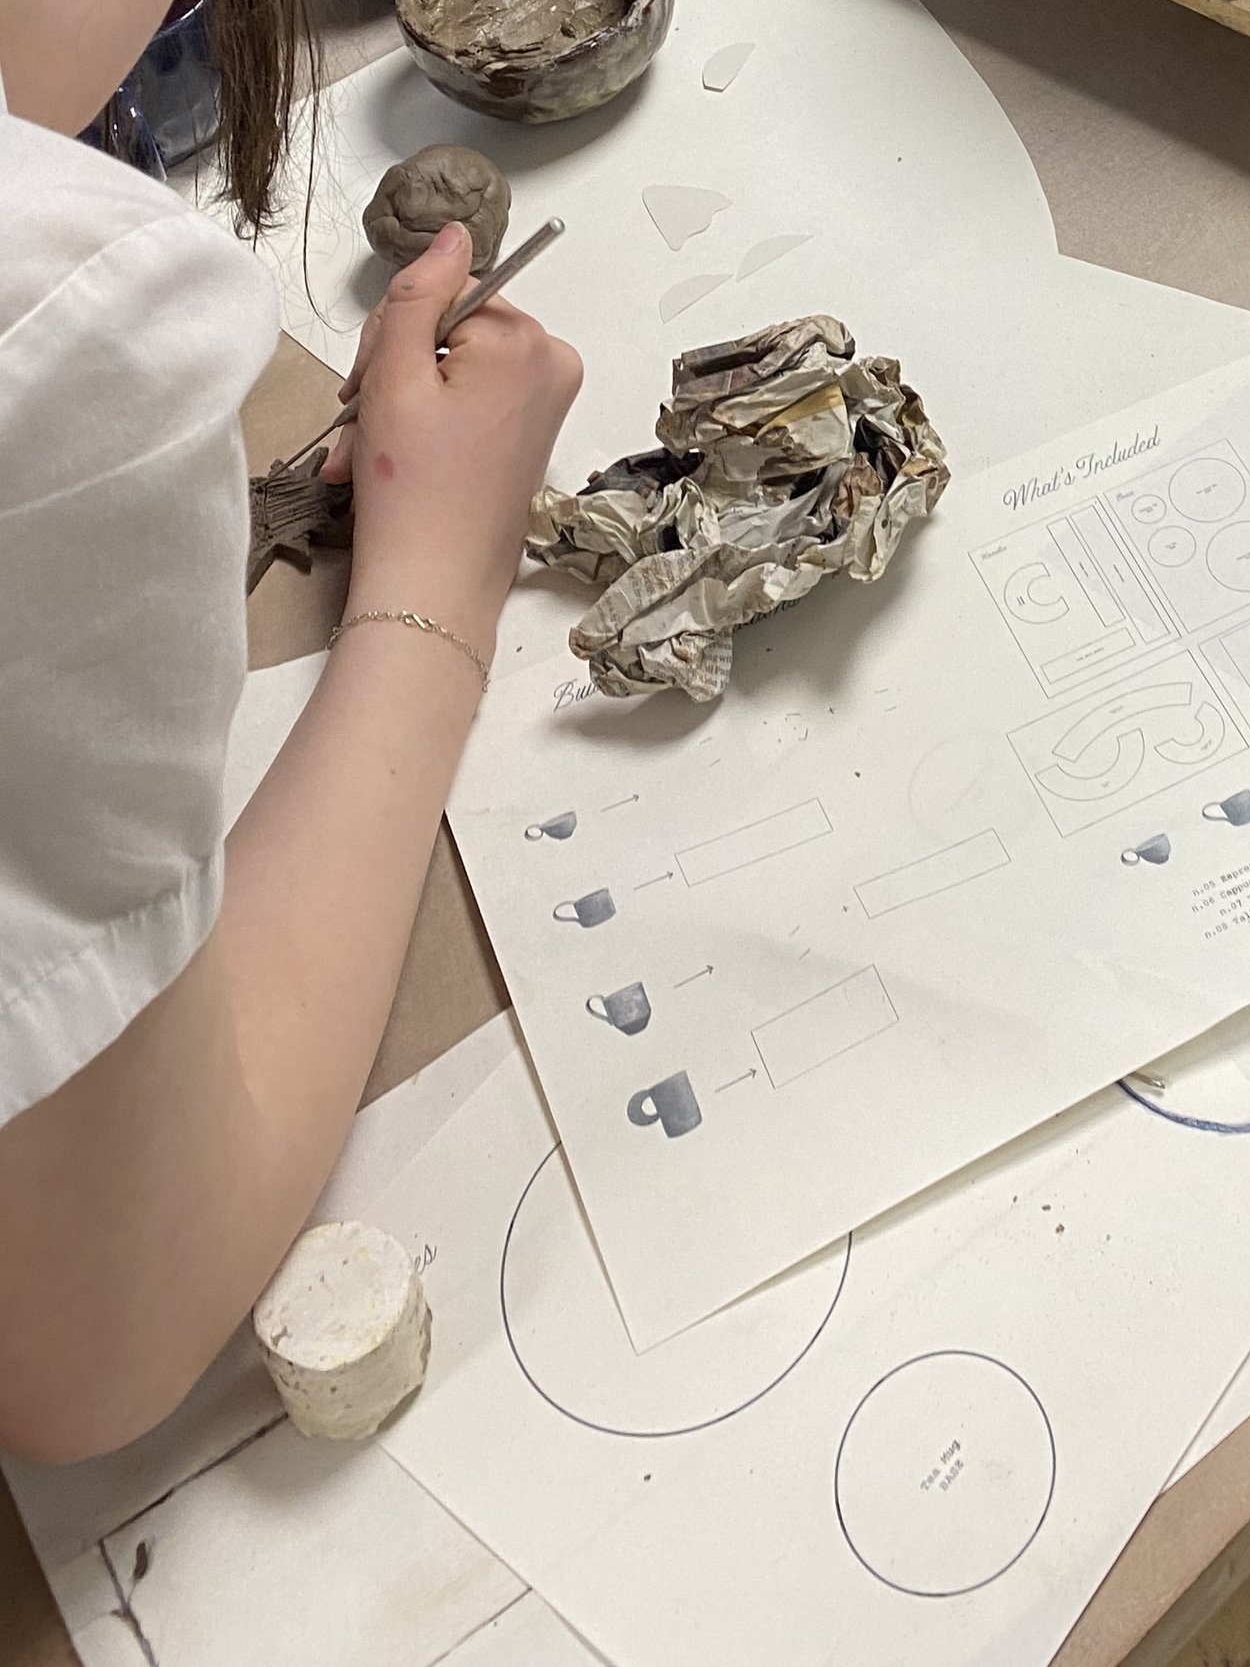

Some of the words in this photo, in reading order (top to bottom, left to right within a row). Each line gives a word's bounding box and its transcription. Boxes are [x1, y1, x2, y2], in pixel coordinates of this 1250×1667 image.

[1002, 466, 1076, 512] What's
[1075, 424, 1161, 479] Included
[1191, 896, 1216, 914] n.06
[1219, 898, 1243, 917] n.07
[1204, 922, 1229, 941] n.08
[940, 1439, 961, 1465] Mug
